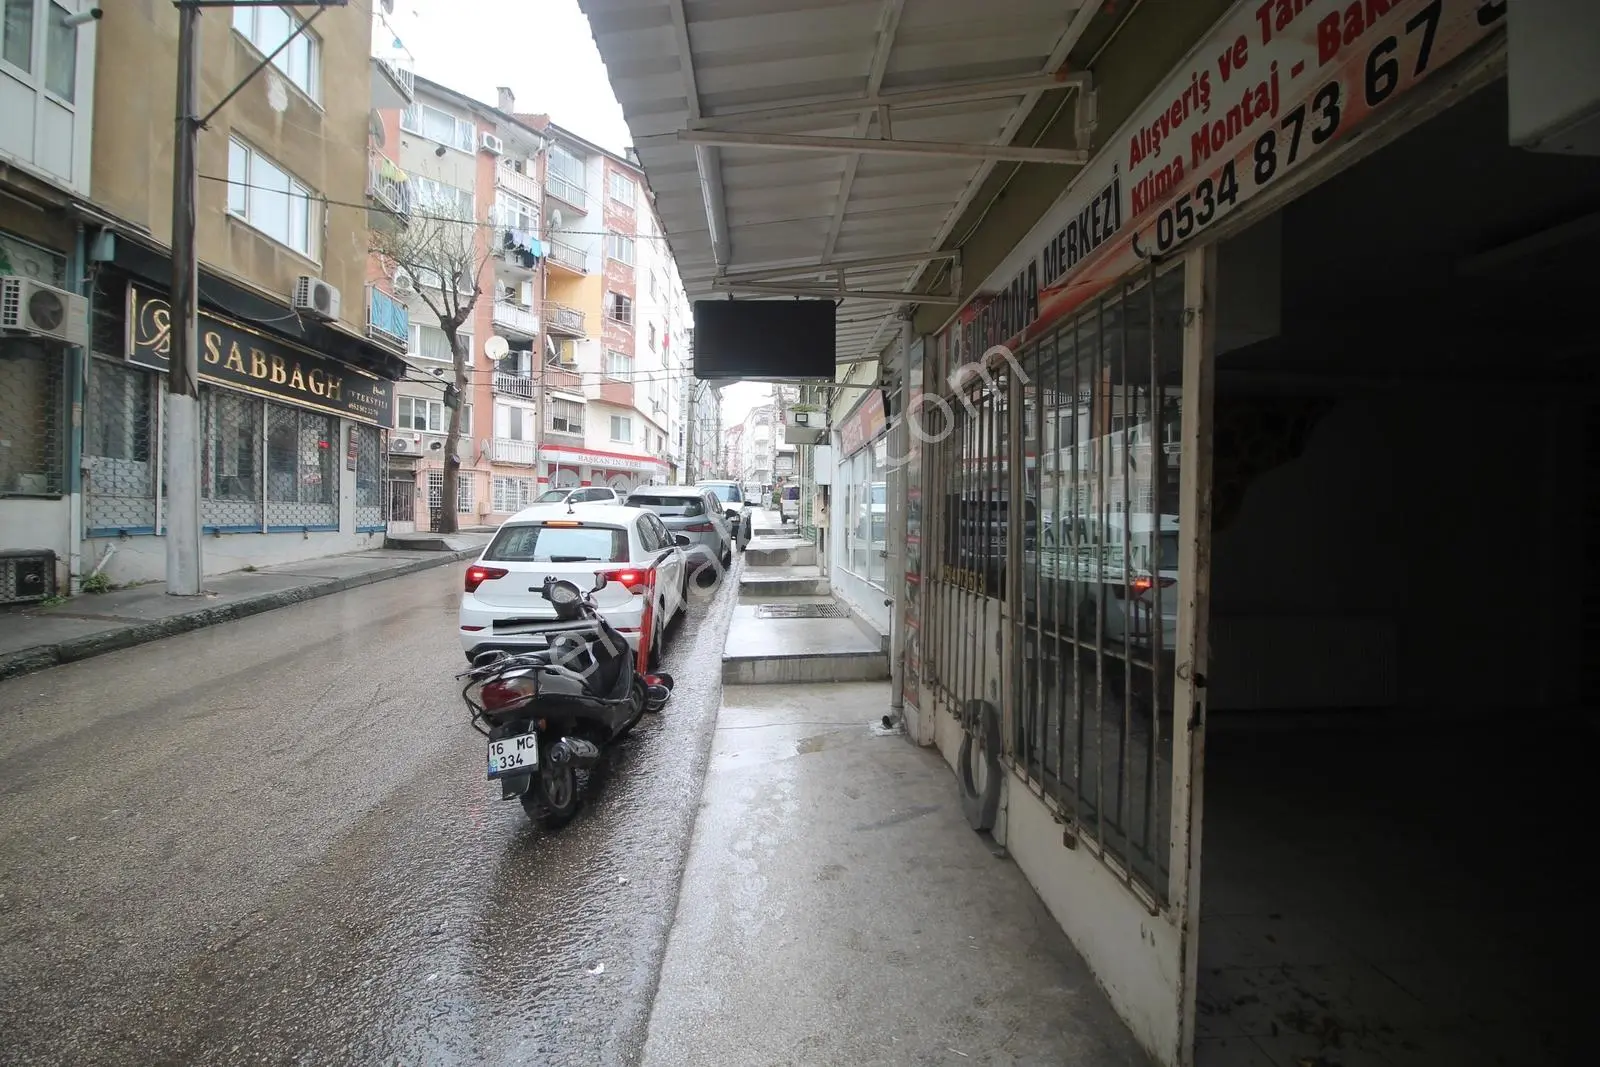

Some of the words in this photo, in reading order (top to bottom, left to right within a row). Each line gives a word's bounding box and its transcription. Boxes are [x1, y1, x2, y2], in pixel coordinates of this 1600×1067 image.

[1129, 71, 1211, 171] Alışveriş
[1218, 34, 1248, 82] ve
[1131, 154, 1184, 218] Klima
[1191, 60, 1279, 170] Montaj
[1155, 158, 1239, 251] 0534
[1253, 80, 1342, 185] 873
[1365, 0, 1442, 107] 67
[1043, 163, 1121, 287] MERKEZİ
[204, 331, 343, 401] SABBAGH
[491, 742, 504, 756] 16
[517, 736, 534, 751] MC
[500, 753, 524, 769] 334
